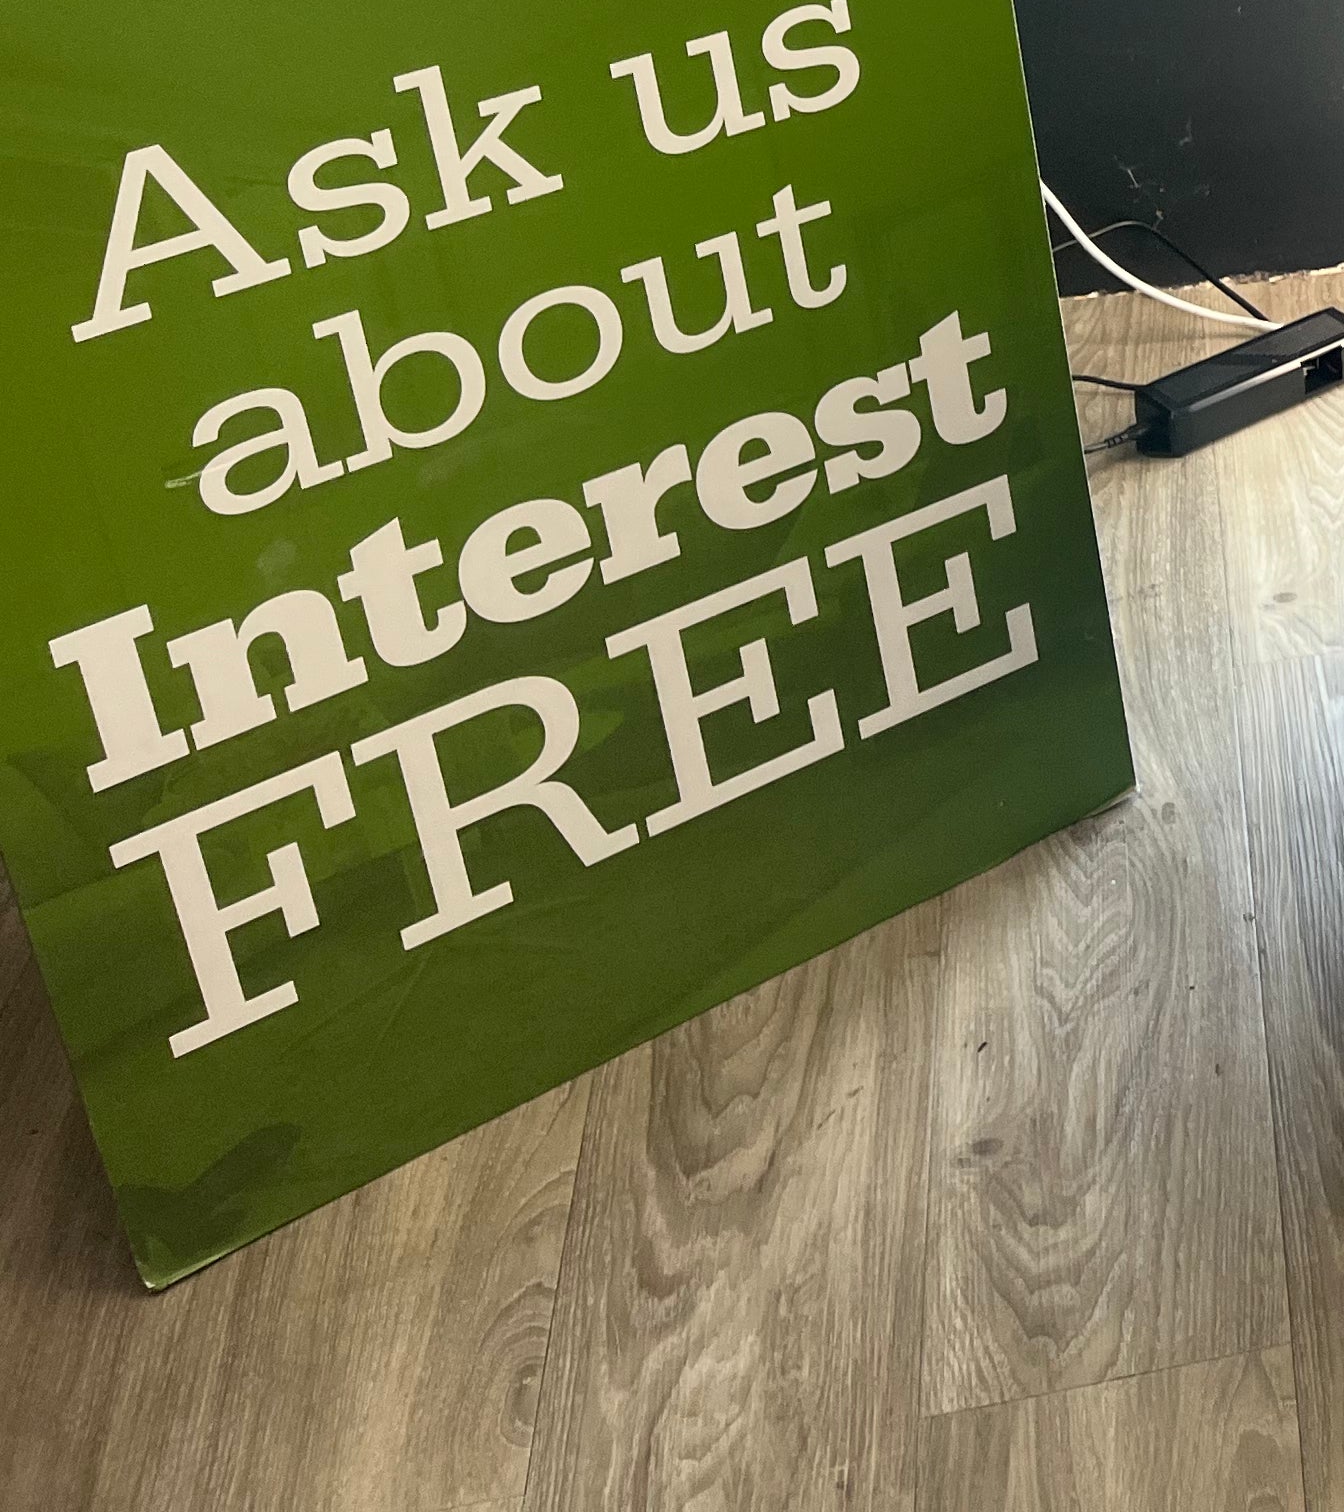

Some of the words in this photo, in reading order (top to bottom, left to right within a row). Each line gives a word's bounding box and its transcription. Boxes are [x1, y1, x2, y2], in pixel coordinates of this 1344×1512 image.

[71, 64, 563, 344] Ask
[189, 183, 848, 516] about
[48, 308, 1007, 793] Interest
[108, 474, 1039, 1058] FREE
